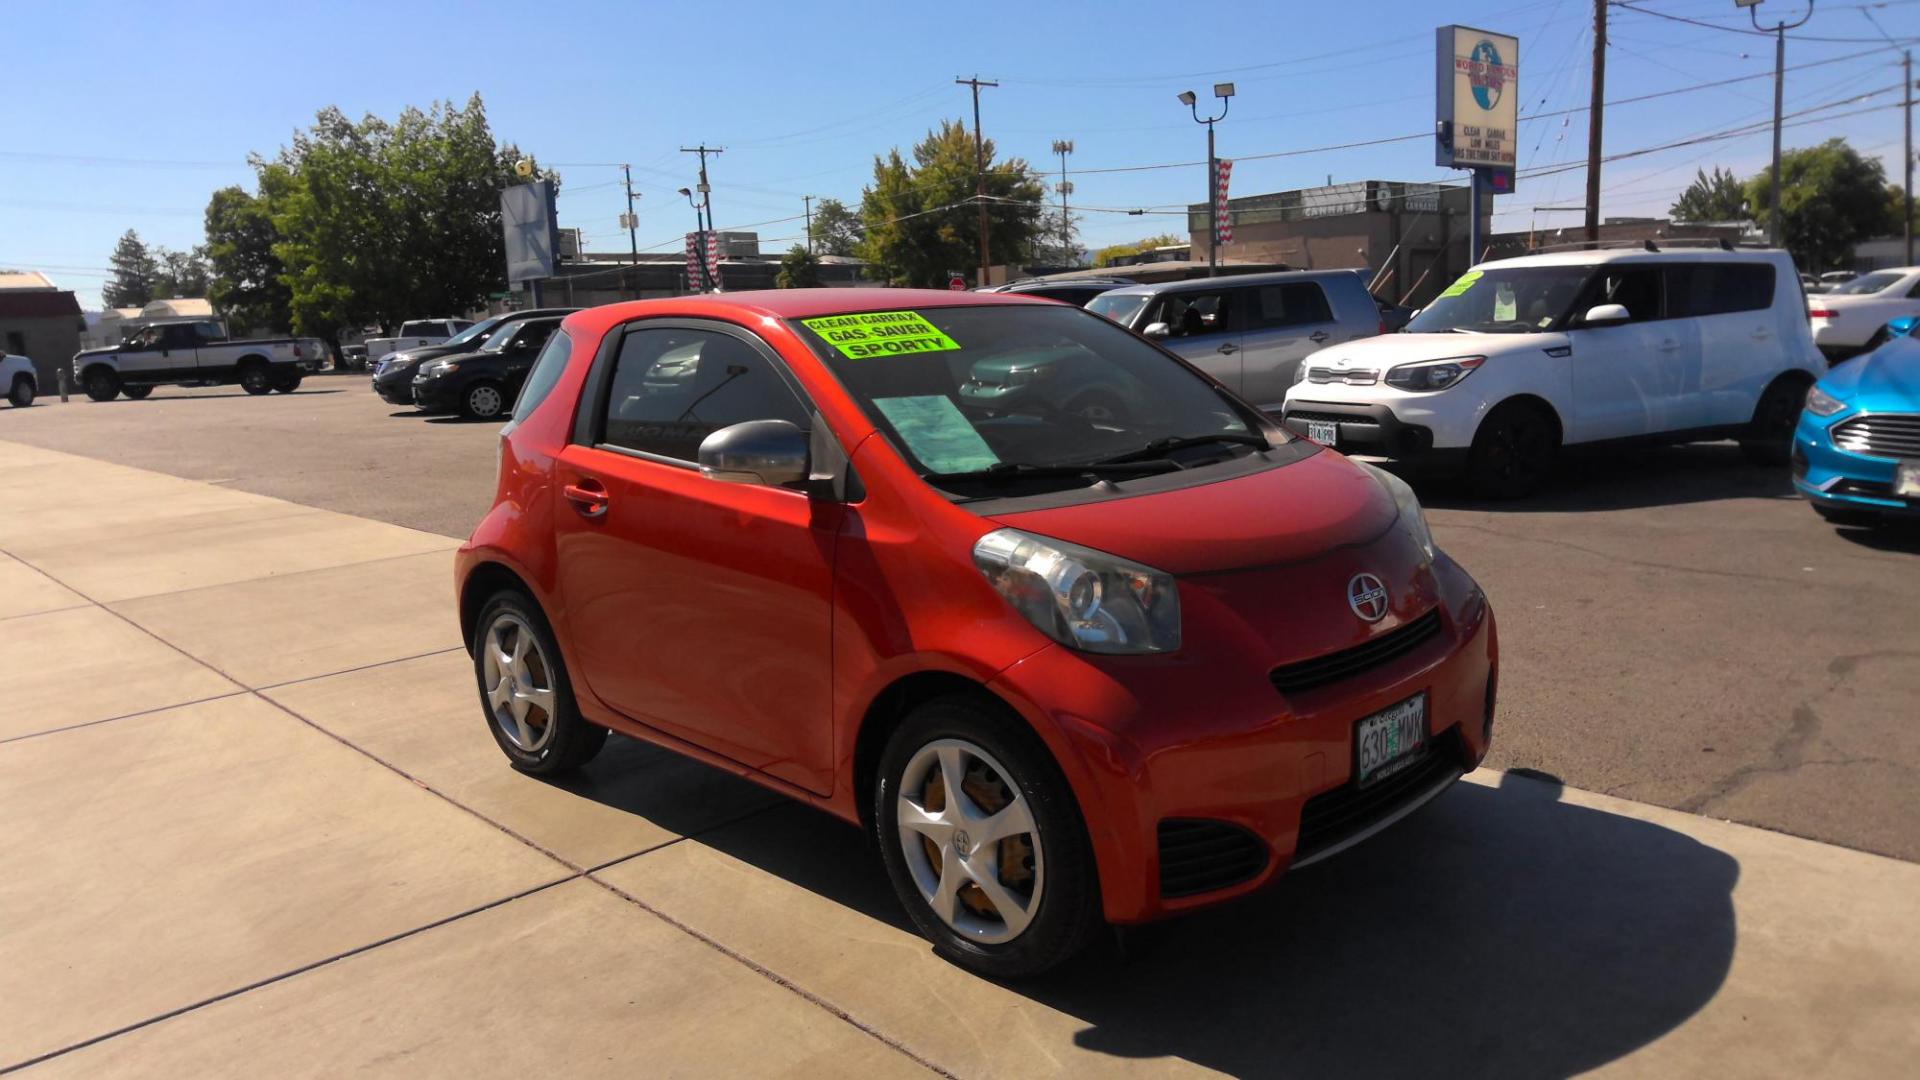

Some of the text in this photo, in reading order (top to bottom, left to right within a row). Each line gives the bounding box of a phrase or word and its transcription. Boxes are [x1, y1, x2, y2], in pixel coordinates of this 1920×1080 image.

[808, 312, 916, 330] CLEAN CARFAX
[849, 337, 944, 356] SPORTY
[1362, 726, 1388, 769] 630
